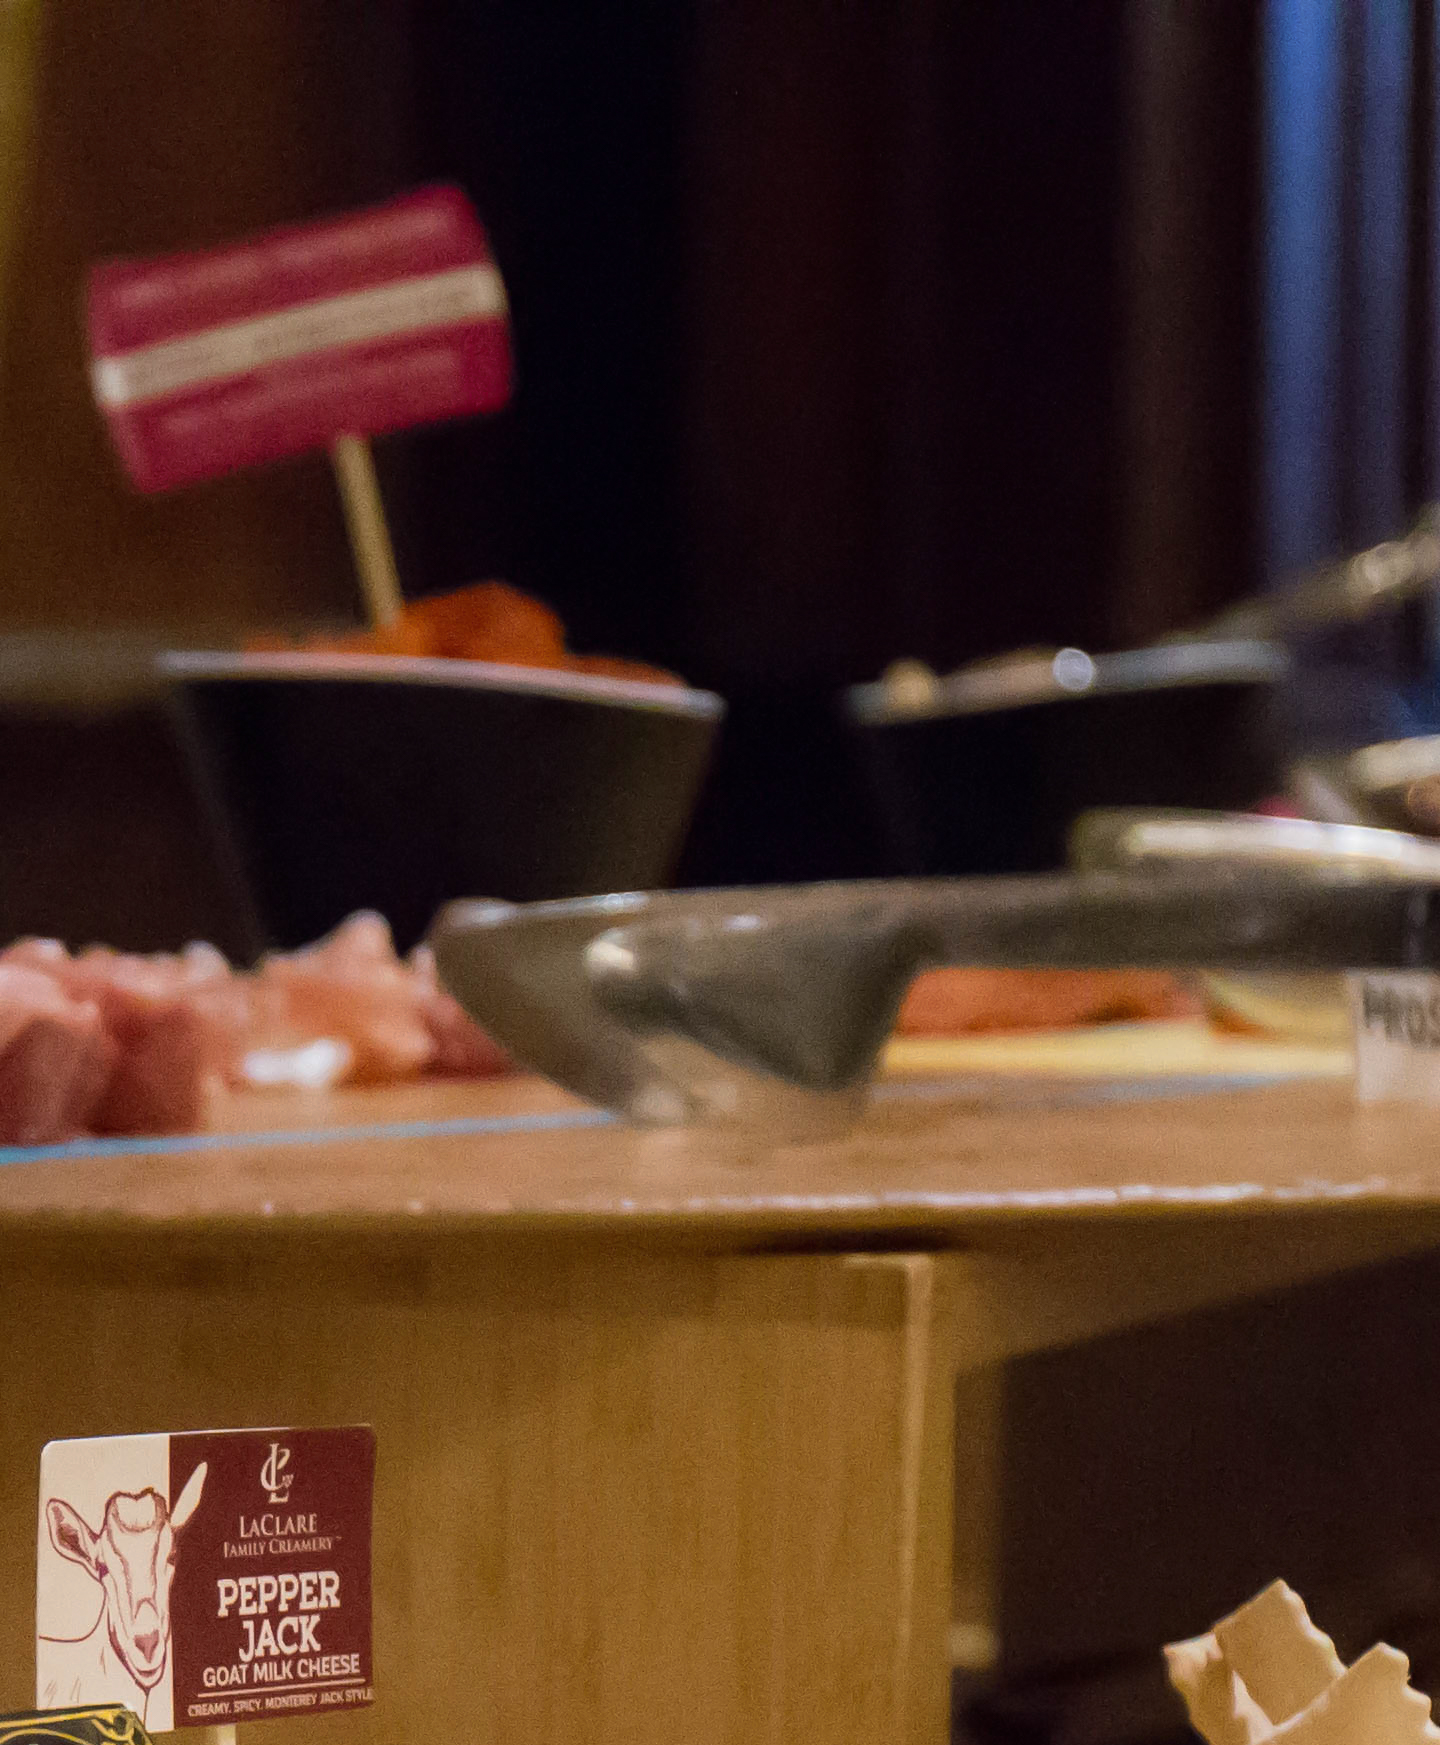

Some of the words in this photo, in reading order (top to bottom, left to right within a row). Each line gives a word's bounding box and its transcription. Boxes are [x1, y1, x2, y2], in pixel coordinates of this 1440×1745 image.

[223, 1541, 267, 1559] FAMILY
[217, 1570, 341, 1618] PEPPER
[238, 1614, 322, 1663] JACK
[203, 1664, 249, 1689] GOAT
[253, 1659, 294, 1684] MILK
[296, 1653, 361, 1678] CHEESE
[265, 1693, 318, 1709] MONTEREY
